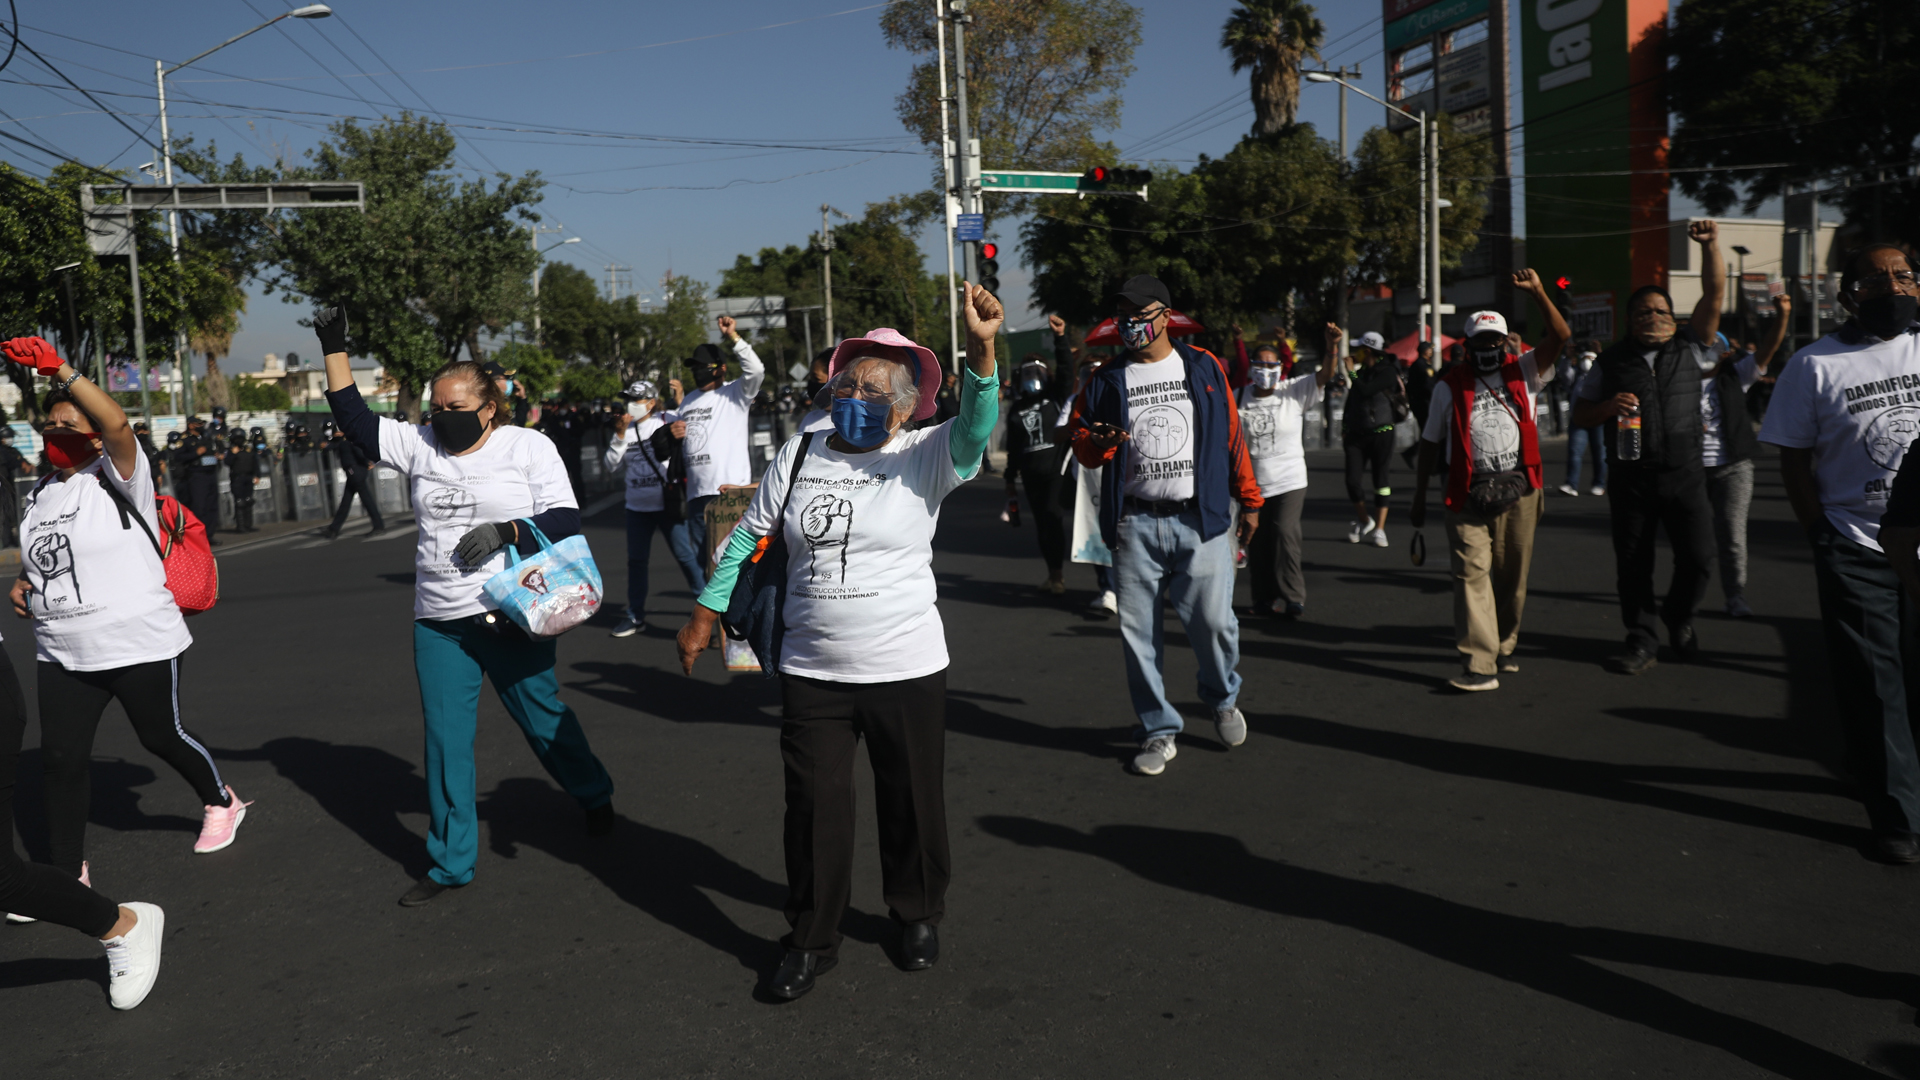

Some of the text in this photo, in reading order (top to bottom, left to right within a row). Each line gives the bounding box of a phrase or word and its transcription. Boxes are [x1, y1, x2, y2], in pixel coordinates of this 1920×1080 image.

[1126, 380, 1188, 398] DAMNIFICADO
[1845, 373, 1920, 401] DAMNIFICA
[1128, 397, 1149, 408] NIDOS
[1150, 396, 1159, 405] DE
[1160, 394, 1169, 403] LA
[1848, 397, 1887, 415] UNIDOS
[1887, 394, 1901, 406] DE
[1901, 392, 1915, 403] LA
[1150, 462, 1161, 473] LA
[1163, 460, 1194, 472] PLANTA
[855, 473, 887, 486] UNOS
[839, 591, 879, 600] TERMINADO
